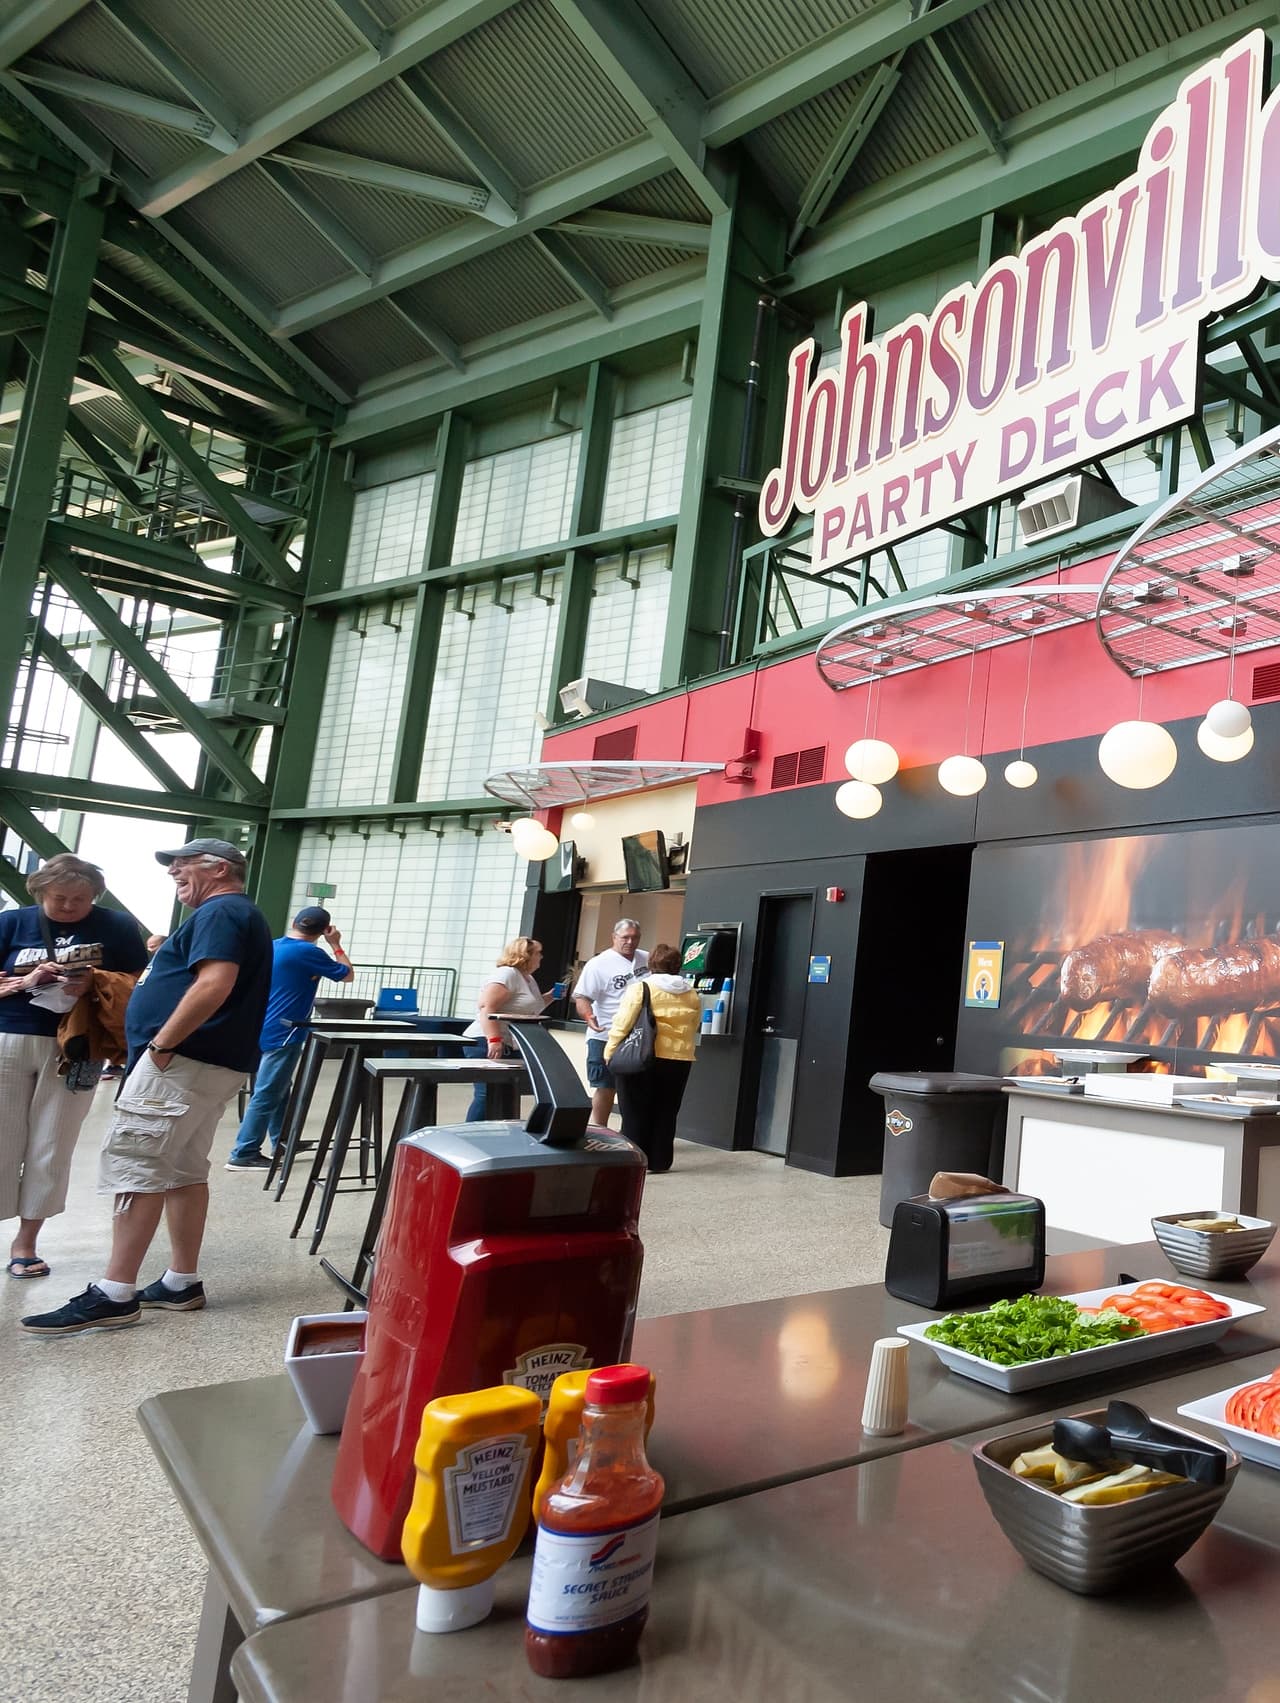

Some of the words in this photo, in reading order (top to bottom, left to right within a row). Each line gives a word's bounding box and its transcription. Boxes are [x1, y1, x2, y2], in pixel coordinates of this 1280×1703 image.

[820, 439, 978, 562] PARTY
[997, 338, 1191, 486] DECK
[530, 1353, 572, 1369] HEINZ
[525, 1371, 562, 1385] TOMA
[474, 1446, 514, 1465] HEINZ
[472, 1464, 512, 1480] YELLOW
[463, 1473, 515, 1495] MUSTARD
[562, 1580, 609, 1595] SECRET
[589, 1586, 630, 1605] SAUCE
